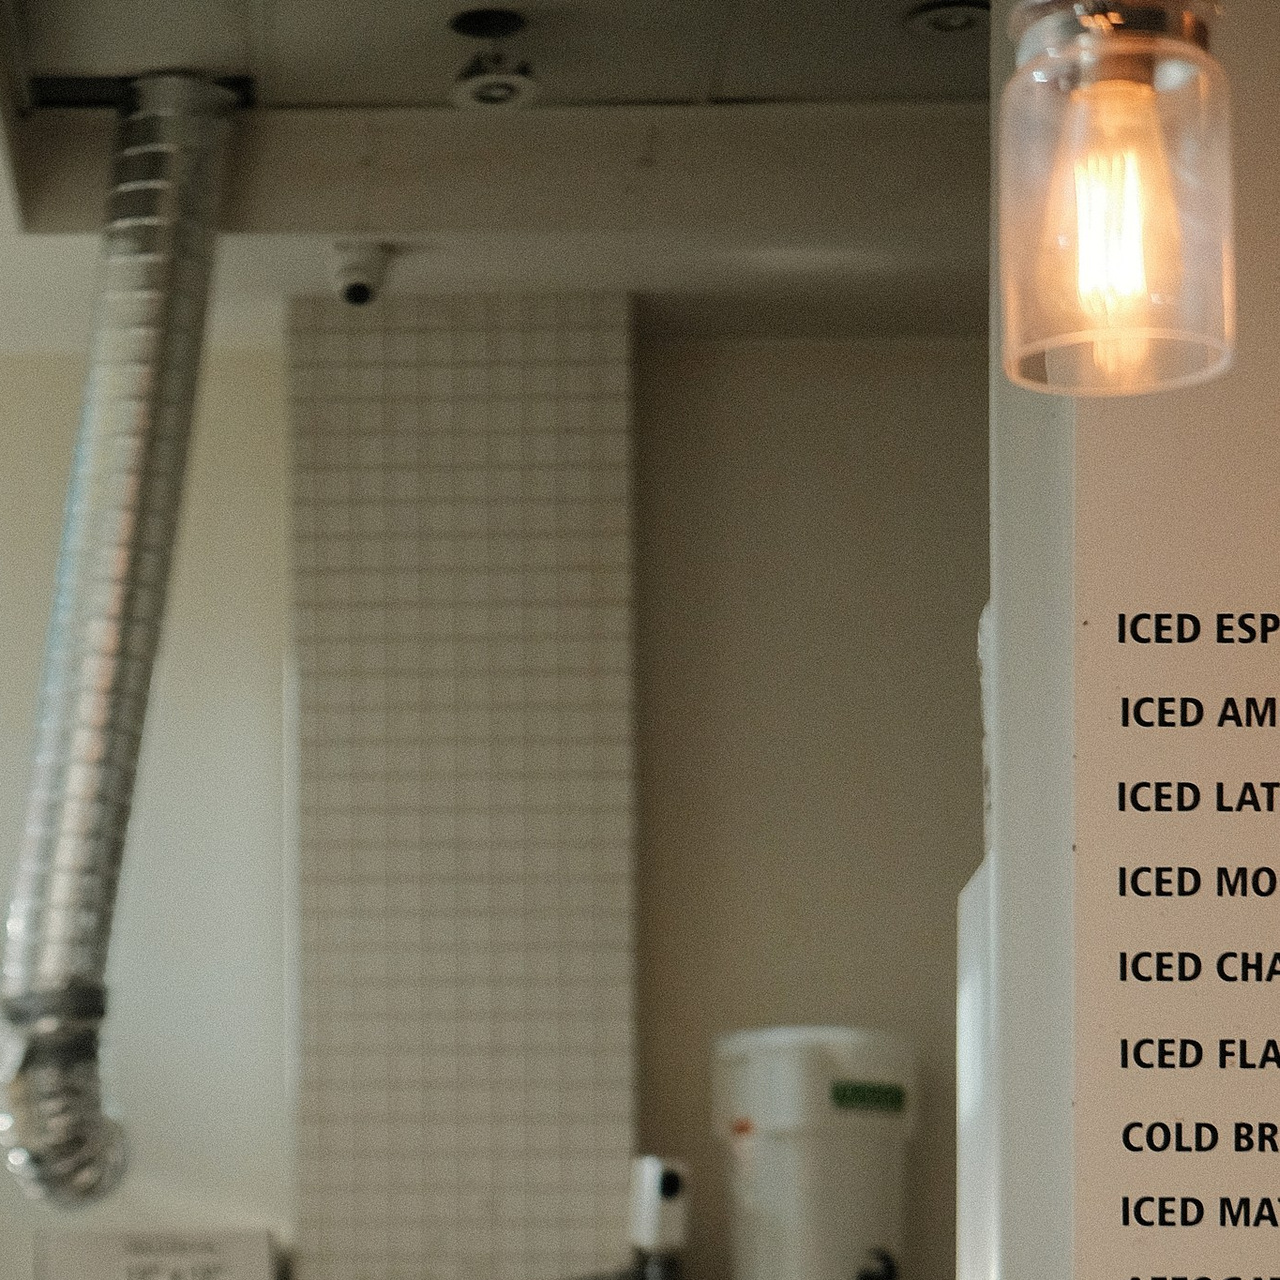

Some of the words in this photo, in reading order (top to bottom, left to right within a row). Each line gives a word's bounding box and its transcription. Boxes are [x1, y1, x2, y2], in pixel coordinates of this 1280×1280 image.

[1118, 613, 1201, 644] ICED
[1216, 613, 1280, 644] ESP
[1121, 696, 1204, 728] ICED
[1217, 697, 1277, 728] AM
[1118, 781, 1201, 812] ICED
[1216, 781, 1280, 812] LAT
[1119, 866, 1202, 897] ICED
[1216, 866, 1277, 897] MO
[1119, 951, 1202, 982] ICED
[1120, 1038, 1204, 1069] ICED
[1219, 1039, 1280, 1069] FLA
[1122, 1121, 1219, 1153] COLD
[1234, 1122, 1279, 1153] BR
[1122, 1196, 1205, 1227] ICED
[1219, 1197, 1279, 1228] MA
